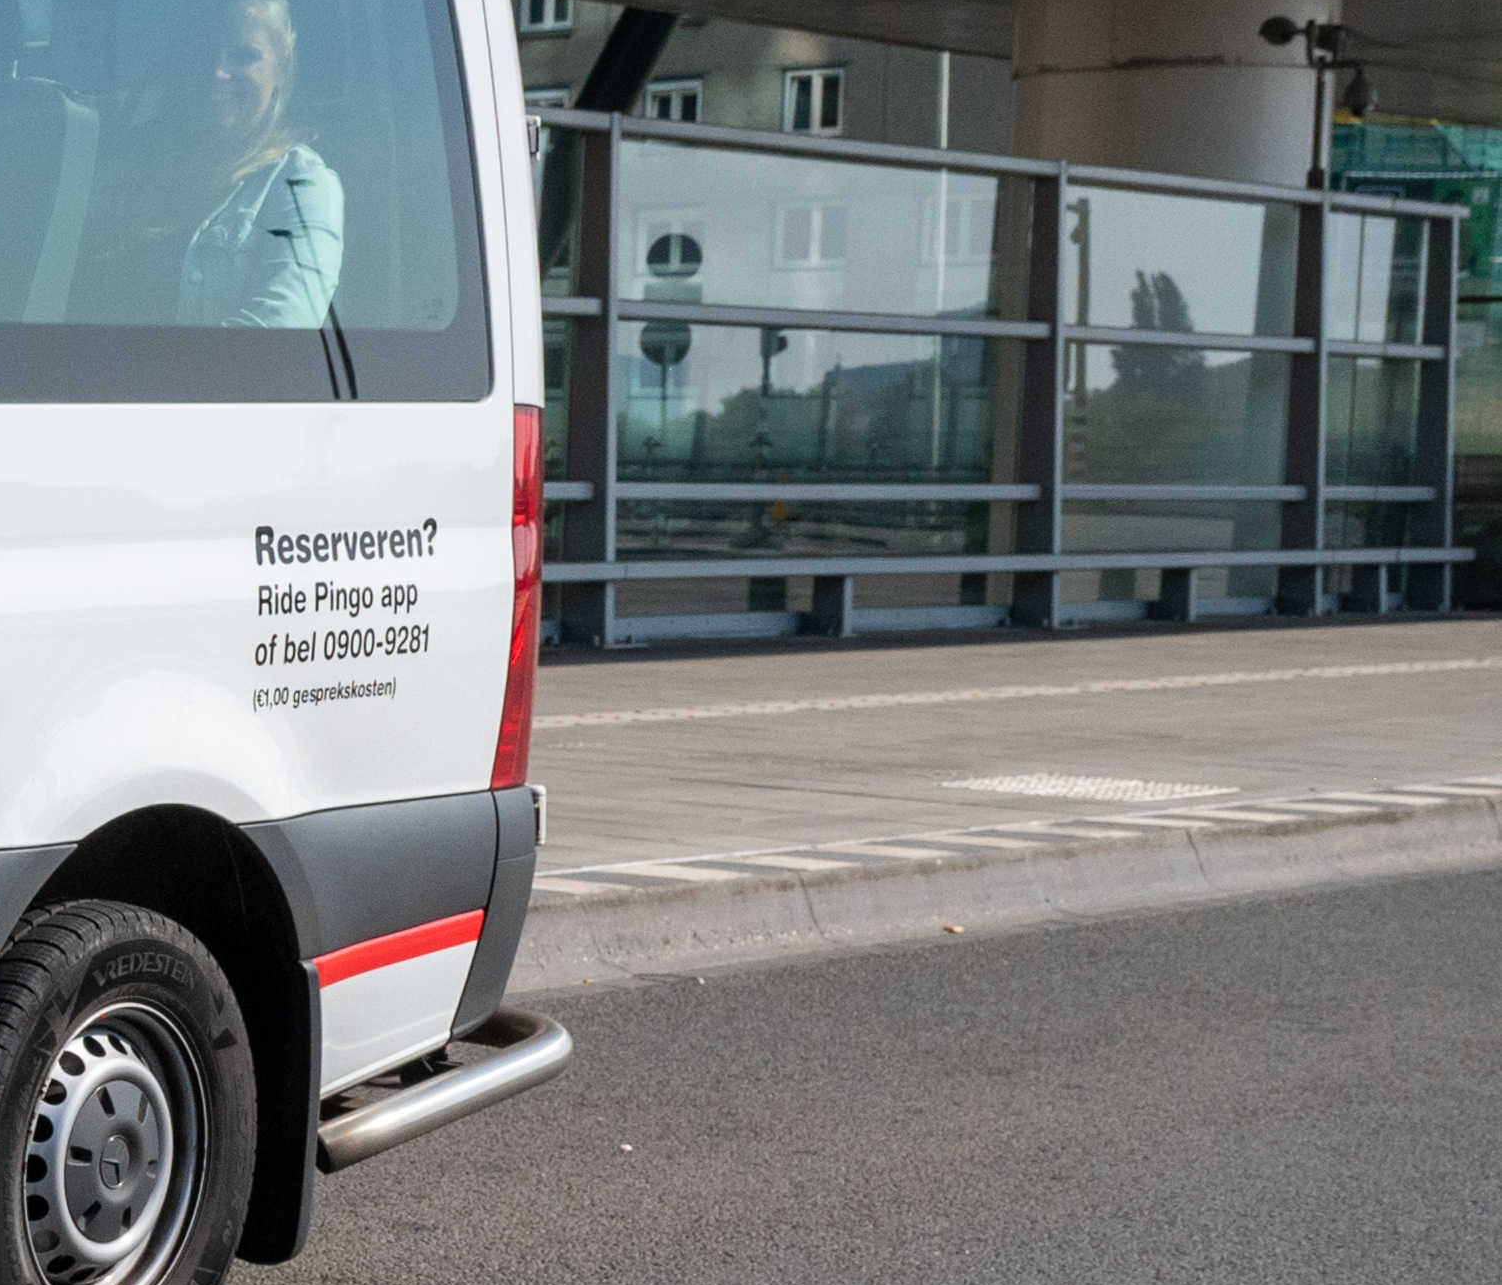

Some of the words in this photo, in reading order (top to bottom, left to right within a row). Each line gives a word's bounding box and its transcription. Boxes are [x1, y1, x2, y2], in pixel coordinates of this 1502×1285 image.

[255, 518, 438, 566] Reserveren?
[258, 583, 307, 616] Ride
[315, 580, 374, 618] Pingo
[381, 583, 418, 614] app
[255, 633, 277, 666] of
[283, 630, 317, 664] bel
[323, 624, 430, 660] 0900-9281
[253, 687, 290, 713] (€1,00
[293, 676, 397, 708] gesprekskosten)
